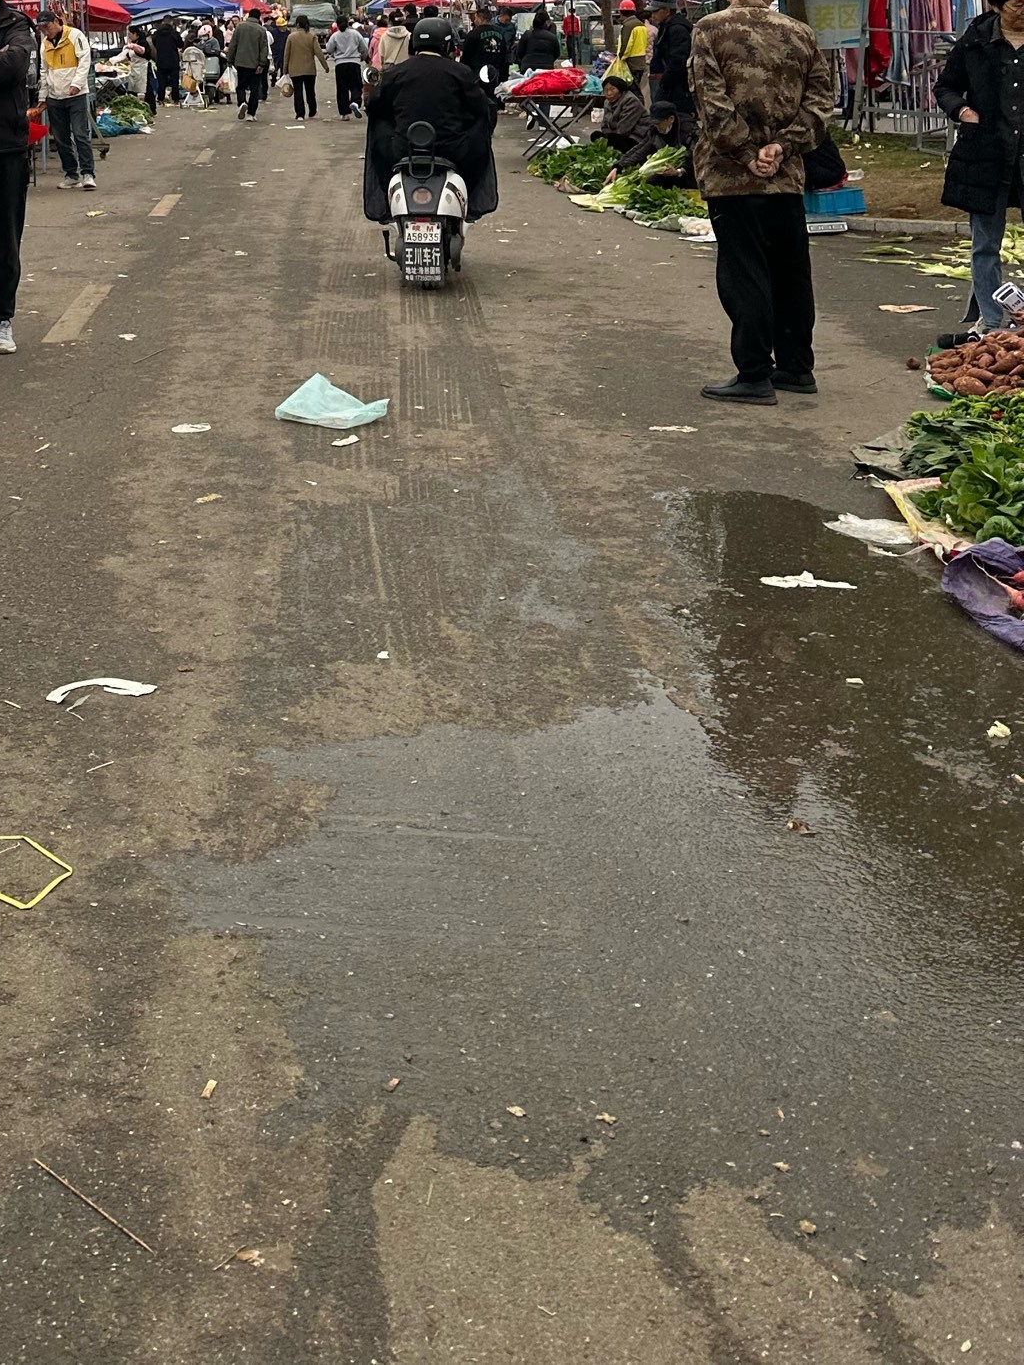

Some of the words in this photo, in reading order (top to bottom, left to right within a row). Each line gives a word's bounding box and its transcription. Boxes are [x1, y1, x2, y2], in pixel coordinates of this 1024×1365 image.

[406, 232, 440, 242] A58935
[405, 247, 441, 266] 王川车行
